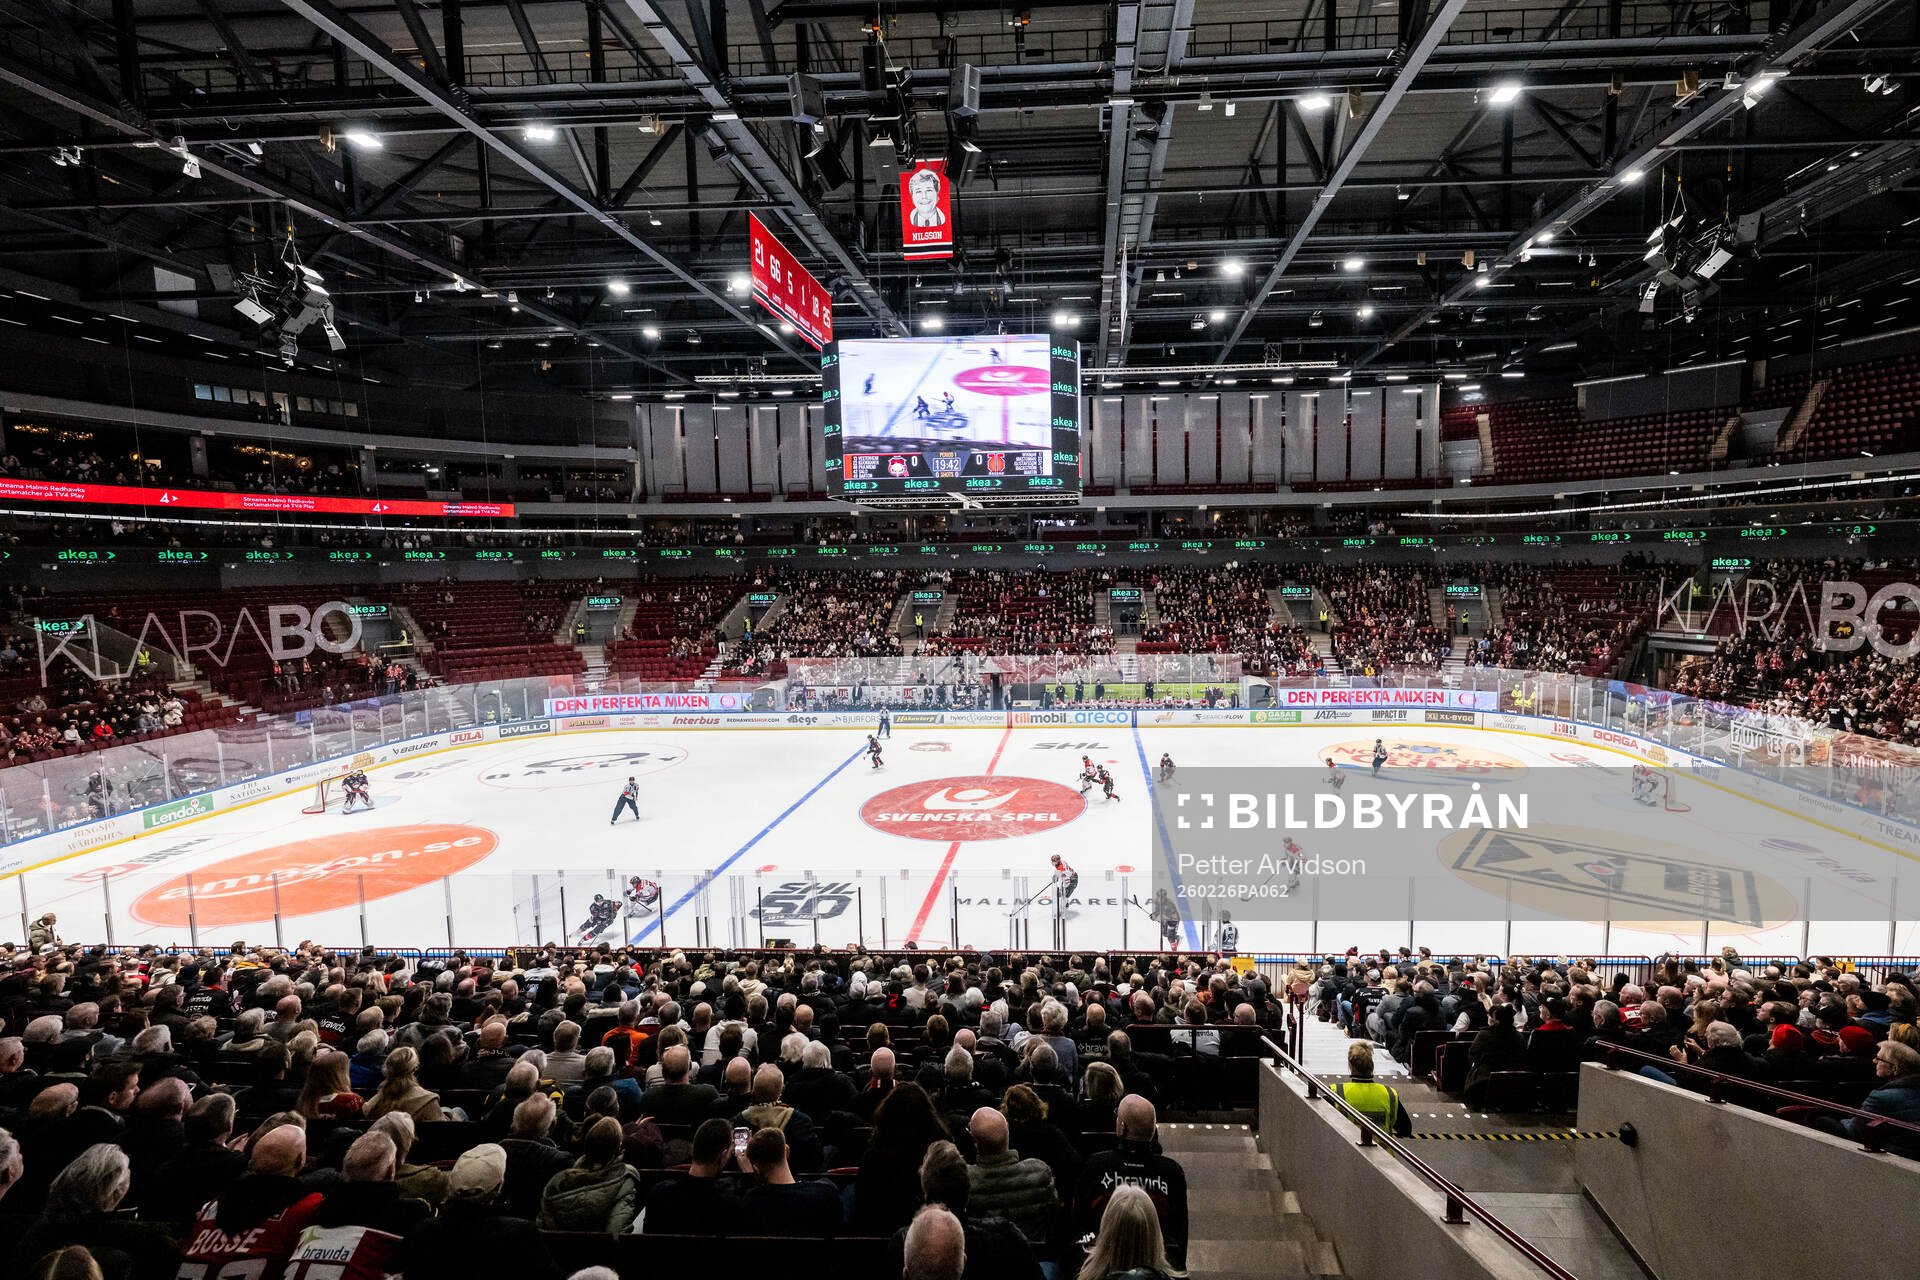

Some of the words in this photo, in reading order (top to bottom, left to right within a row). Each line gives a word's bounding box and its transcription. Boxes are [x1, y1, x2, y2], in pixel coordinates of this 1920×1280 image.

[912, 231, 943, 240] NILSSON
[754, 238, 765, 268] 21
[769, 254, 781, 283] 66
[787, 270, 793, 295] 5
[801, 285, 805, 306] 1
[822, 305, 831, 329] 25
[1052, 346, 1072, 358] akea
[1052, 381, 1073, 393] akea
[1053, 416, 1073, 428] akea
[911, 456, 918, 466] 0
[976, 454, 982, 465] 0
[1054, 451, 1073, 461] akea
[935, 459, 959, 470] 19:42
[844, 481, 867, 490] akea
[904, 479, 928, 488] akea
[966, 478, 991, 487] akea
[1028, 476, 1053, 485] akea
[50, 485, 86, 493] Redhawks
[0, 489, 43, 497] ortamatcher
[70, 492, 85, 500] Play
[160, 492, 170, 504] 4
[372, 503, 381, 512] 4
[1591, 532, 1619, 541] akea
[1663, 530, 1694, 539] akea
[1740, 527, 1772, 537] akea
[1343, 538, 1366, 546] akea
[1400, 537, 1424, 545] akea
[1523, 534, 1553, 544] akea
[972, 544, 993, 552] akea
[1076, 543, 1098, 551] akea
[1182, 541, 1203, 549] akea
[58, 548, 98, 560] akea
[157, 549, 193, 560] akea
[245, 550, 280, 560] akea
[330, 550, 361, 560] akea
[405, 550, 433, 559] akea
[476, 550, 502, 558] akea
[603, 549, 626, 557] akea
[660, 548, 682, 556] akea
[1712, 557, 1739, 566] akea
[1111, 589, 1131, 597] akea
[1281, 586, 1303, 594] akea
[1446, 585, 1468, 593] akea
[588, 596, 611, 604] akea
[750, 593, 769, 601] akea
[914, 591, 934, 599] akea
[348, 604, 375, 614] akea
[1657, 576, 1920, 660] KLARABO
[33, 620, 69, 632] akea
[34, 600, 363, 688] KLARABO
[1288, 691, 1317, 703] DEN
[1322, 690, 1390, 703] PERFEKTA
[1394, 690, 1445, 704] MIXEN
[555, 698, 588, 712] DEN
[592, 695, 661, 710] PERFEKTA
[664, 694, 709, 708] MIXEN
[1015, 711, 1067, 724] tillmobil
[1075, 710, 1129, 724] areco
[1372, 710, 1397, 719] IMPACT
[1398, 710, 1408, 719] BY
[1440, 714, 1474, 722] XL-BYGG
[672, 715, 720, 726] Interbus
[500, 722, 549, 735] DIVELLO
[451, 730, 482, 744] JULA
[1593, 729, 1639, 750] BORGA
[1030, 742, 1111, 750] SHL
[1798, 794, 1844, 815] ticketmaster
[874, 812, 994, 823] SVENSKA
[1001, 812, 1062, 823] SPEL
[769, 882, 857, 895] SHL
[748, 894, 852, 920] 50
[185, 1228, 266, 1256] BOSSE
[302, 1246, 350, 1261] bravida
